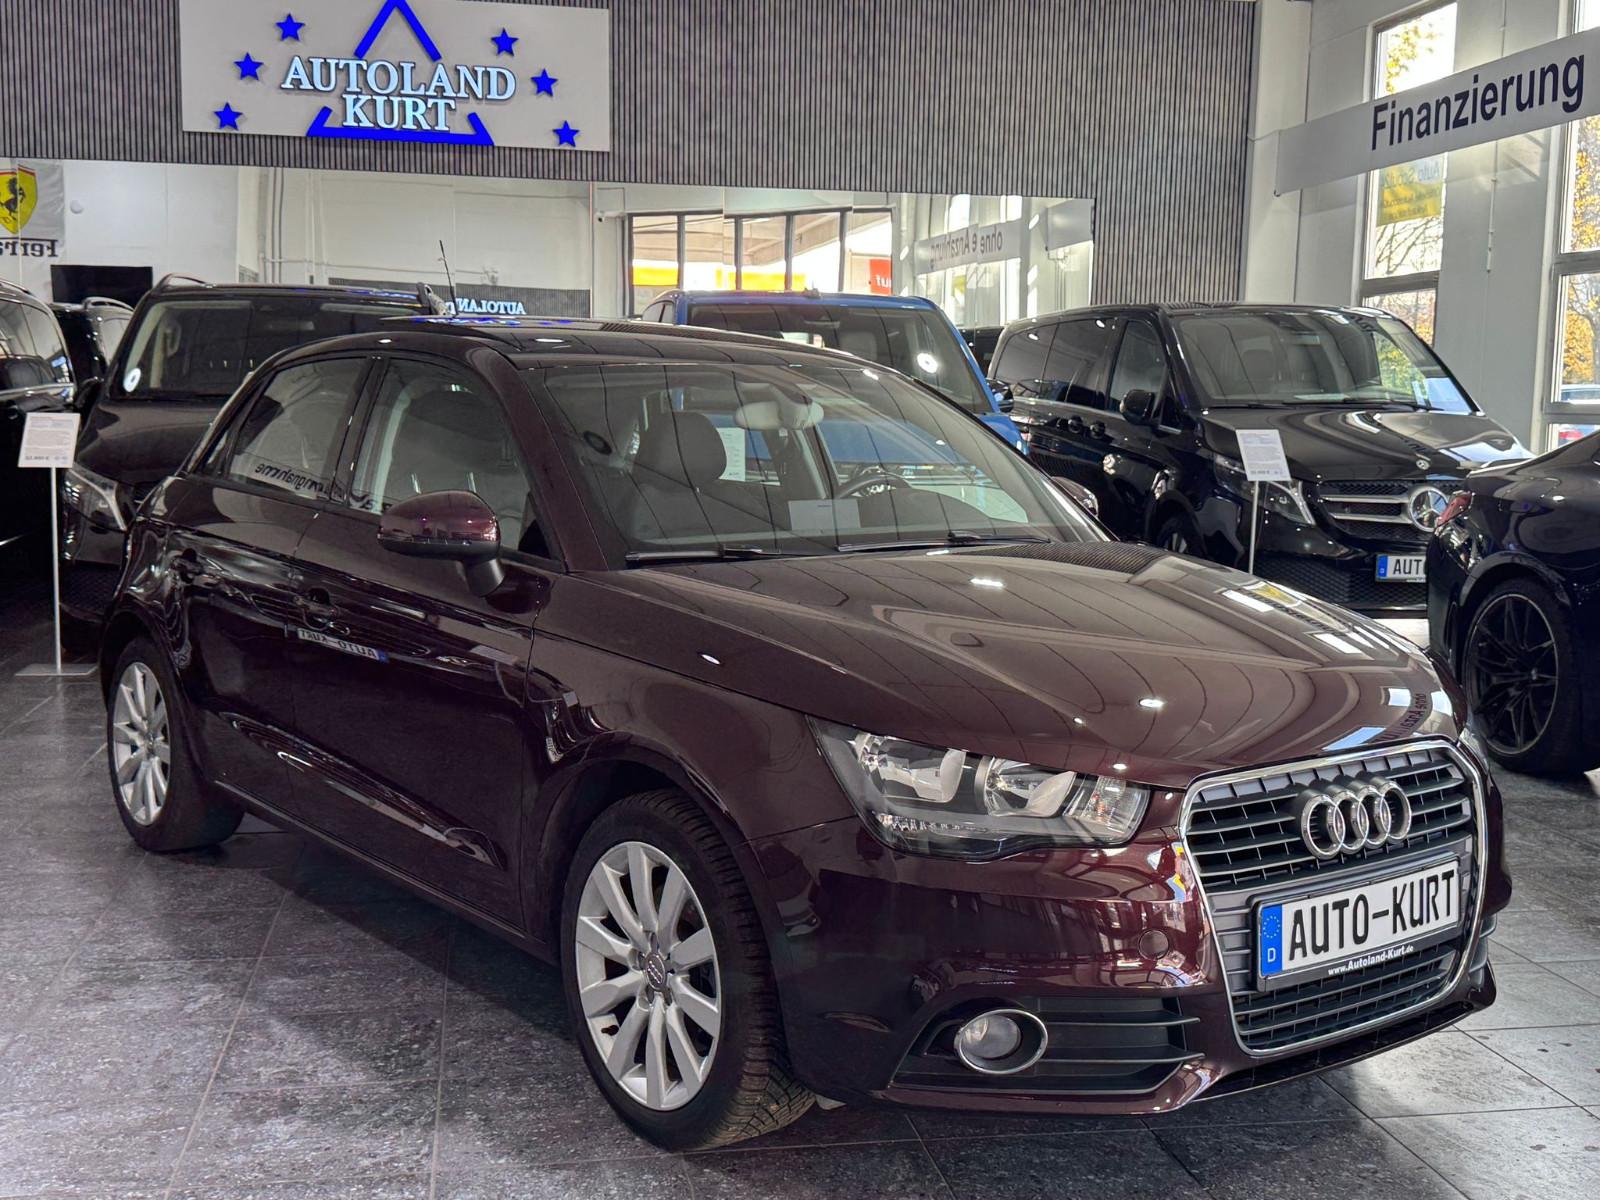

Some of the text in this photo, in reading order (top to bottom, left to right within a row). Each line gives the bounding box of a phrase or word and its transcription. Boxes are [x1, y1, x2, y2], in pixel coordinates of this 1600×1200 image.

[280, 55, 516, 101] AUTOLAND
[342, 94, 456, 131] KURT
[1371, 54, 1585, 150] Finanzierung
[1267, 869, 1455, 963] D AUTO-KURT
[1328, 944, 1414, 976] www.Autoland-Kurt.de
